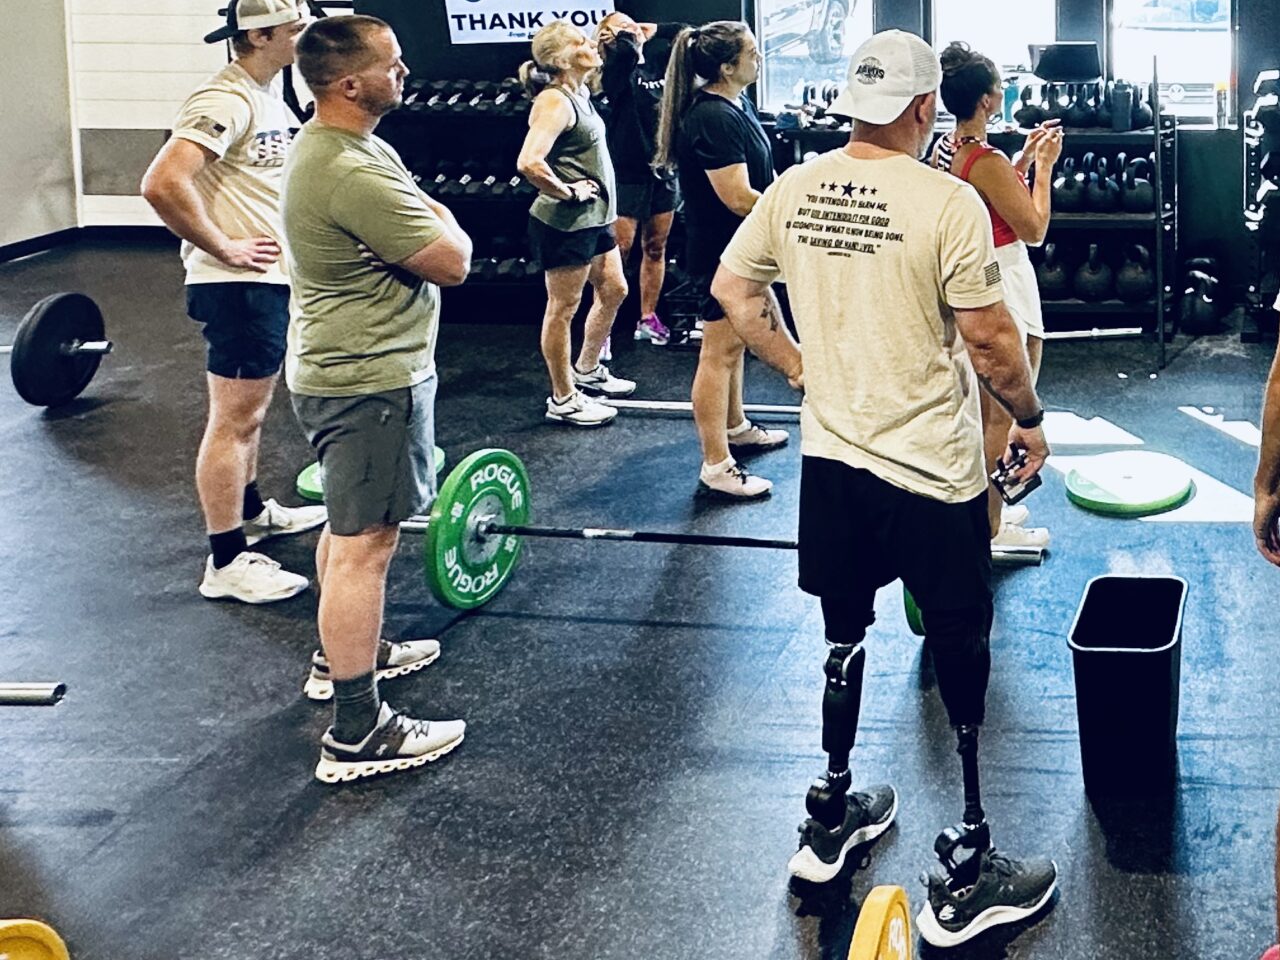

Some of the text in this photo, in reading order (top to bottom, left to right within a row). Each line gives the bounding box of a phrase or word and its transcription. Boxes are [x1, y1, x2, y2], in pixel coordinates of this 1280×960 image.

[450, 11, 544, 31] THANK
[469, 463, 523, 511] ROGUE
[444, 546, 499, 594] ROGUE
